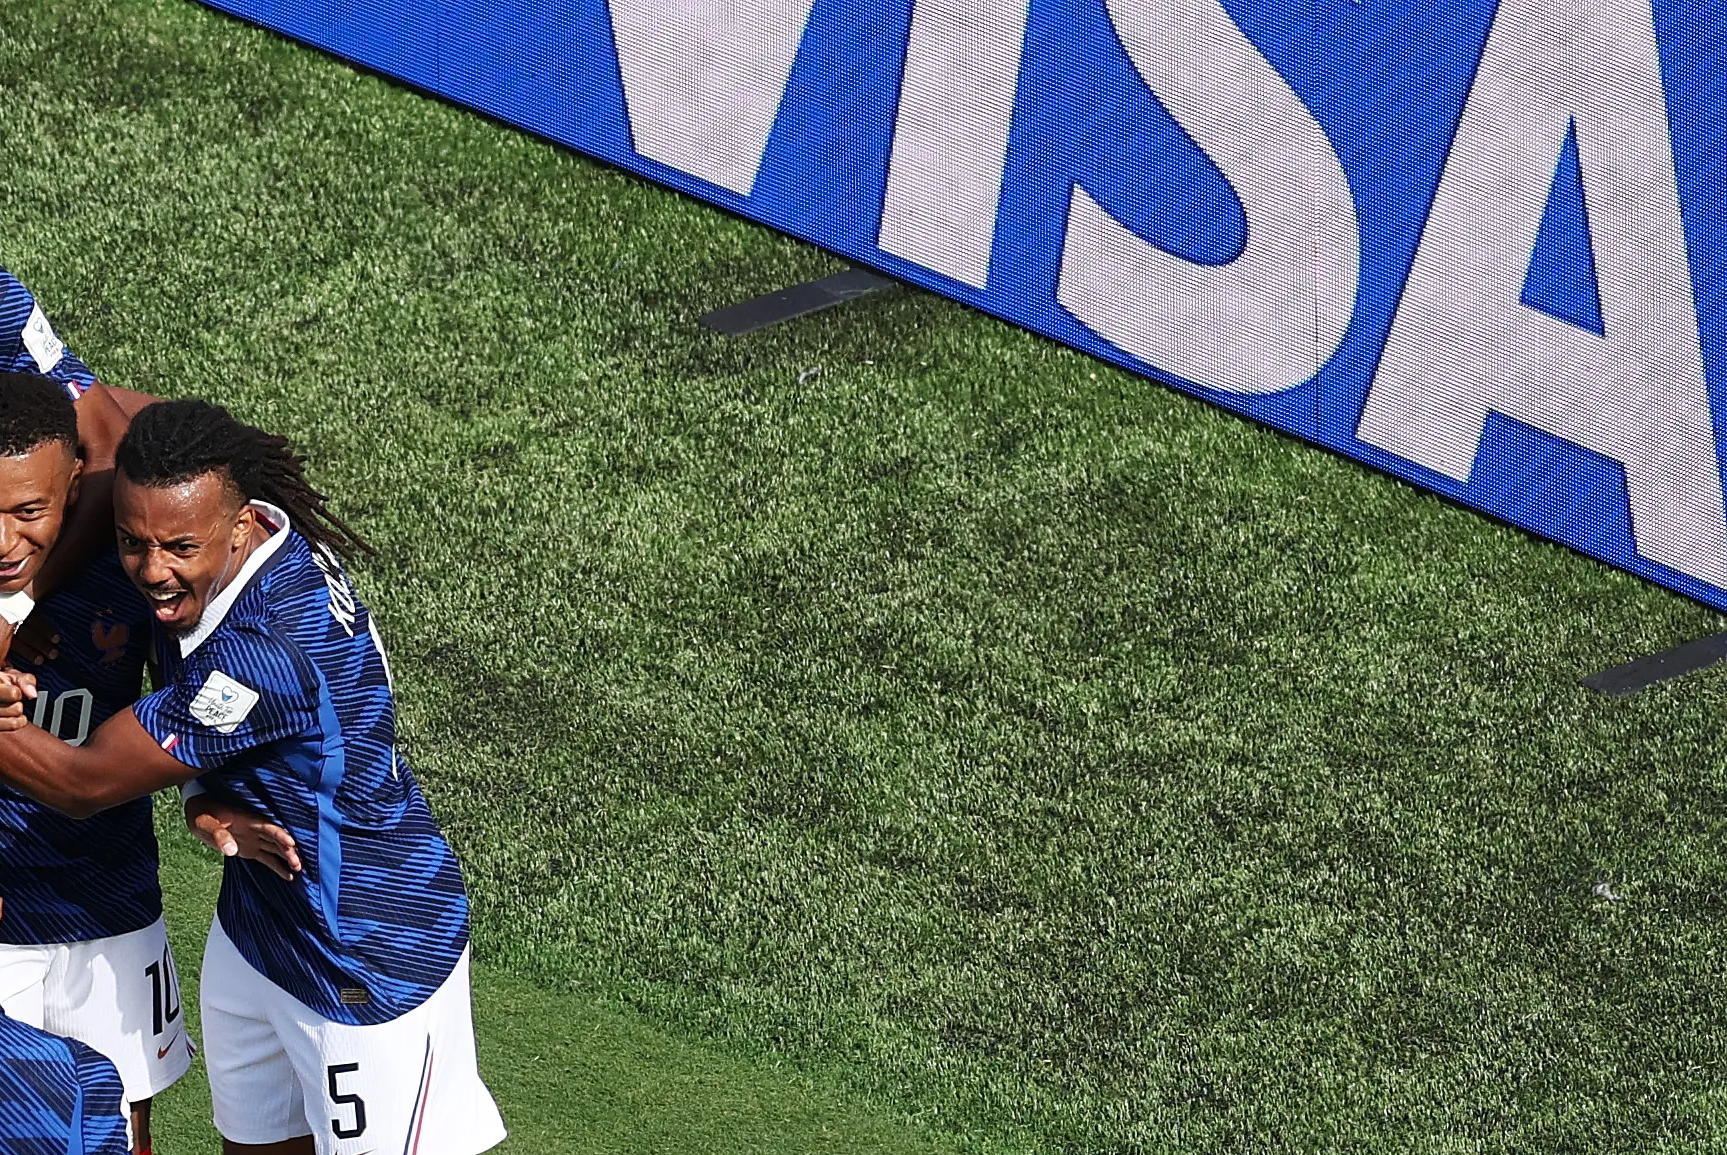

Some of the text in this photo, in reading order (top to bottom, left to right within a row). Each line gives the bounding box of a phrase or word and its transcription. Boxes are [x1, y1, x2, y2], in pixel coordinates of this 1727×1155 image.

[33, 688, 93, 747] 10
[145, 941, 180, 1036] 10
[327, 1062, 367, 1140] 5
